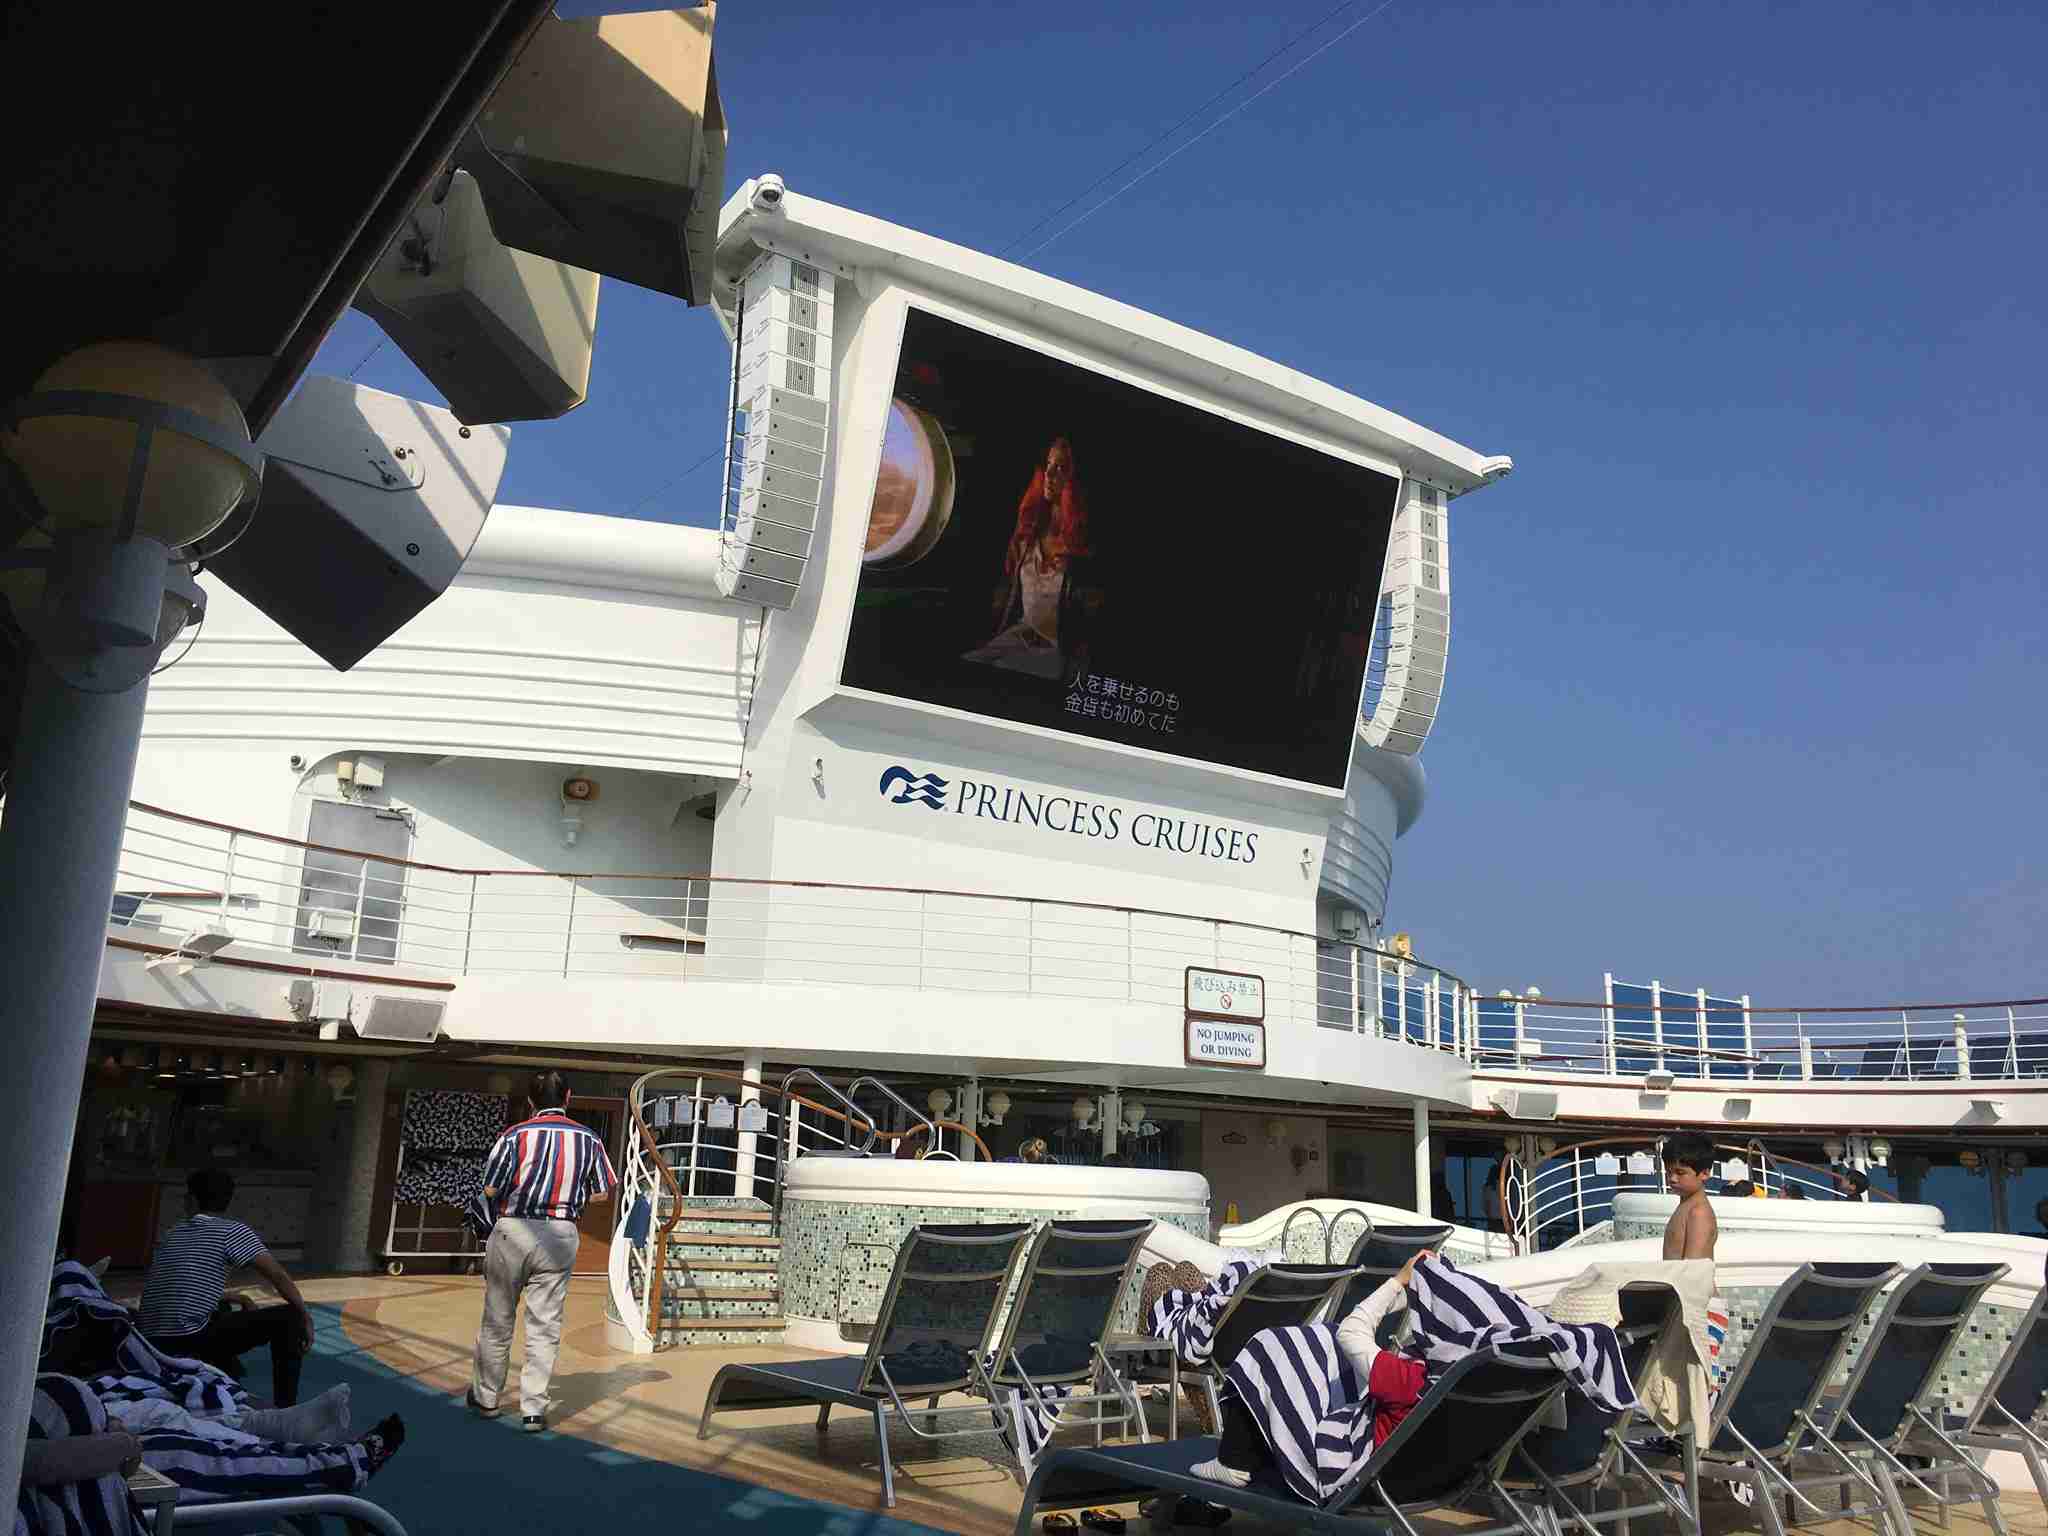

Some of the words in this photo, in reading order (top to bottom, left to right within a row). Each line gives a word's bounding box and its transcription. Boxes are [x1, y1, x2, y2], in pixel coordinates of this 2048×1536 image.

[955, 780, 1122, 839] PRINCESS
[1131, 813, 1259, 864] CRUISES
[1197, 1029, 1212, 1040] NO
[1214, 1031, 1255, 1044] JUMPING
[1201, 1044, 1215, 1055] OR
[1217, 1046, 1252, 1057] DIVING
